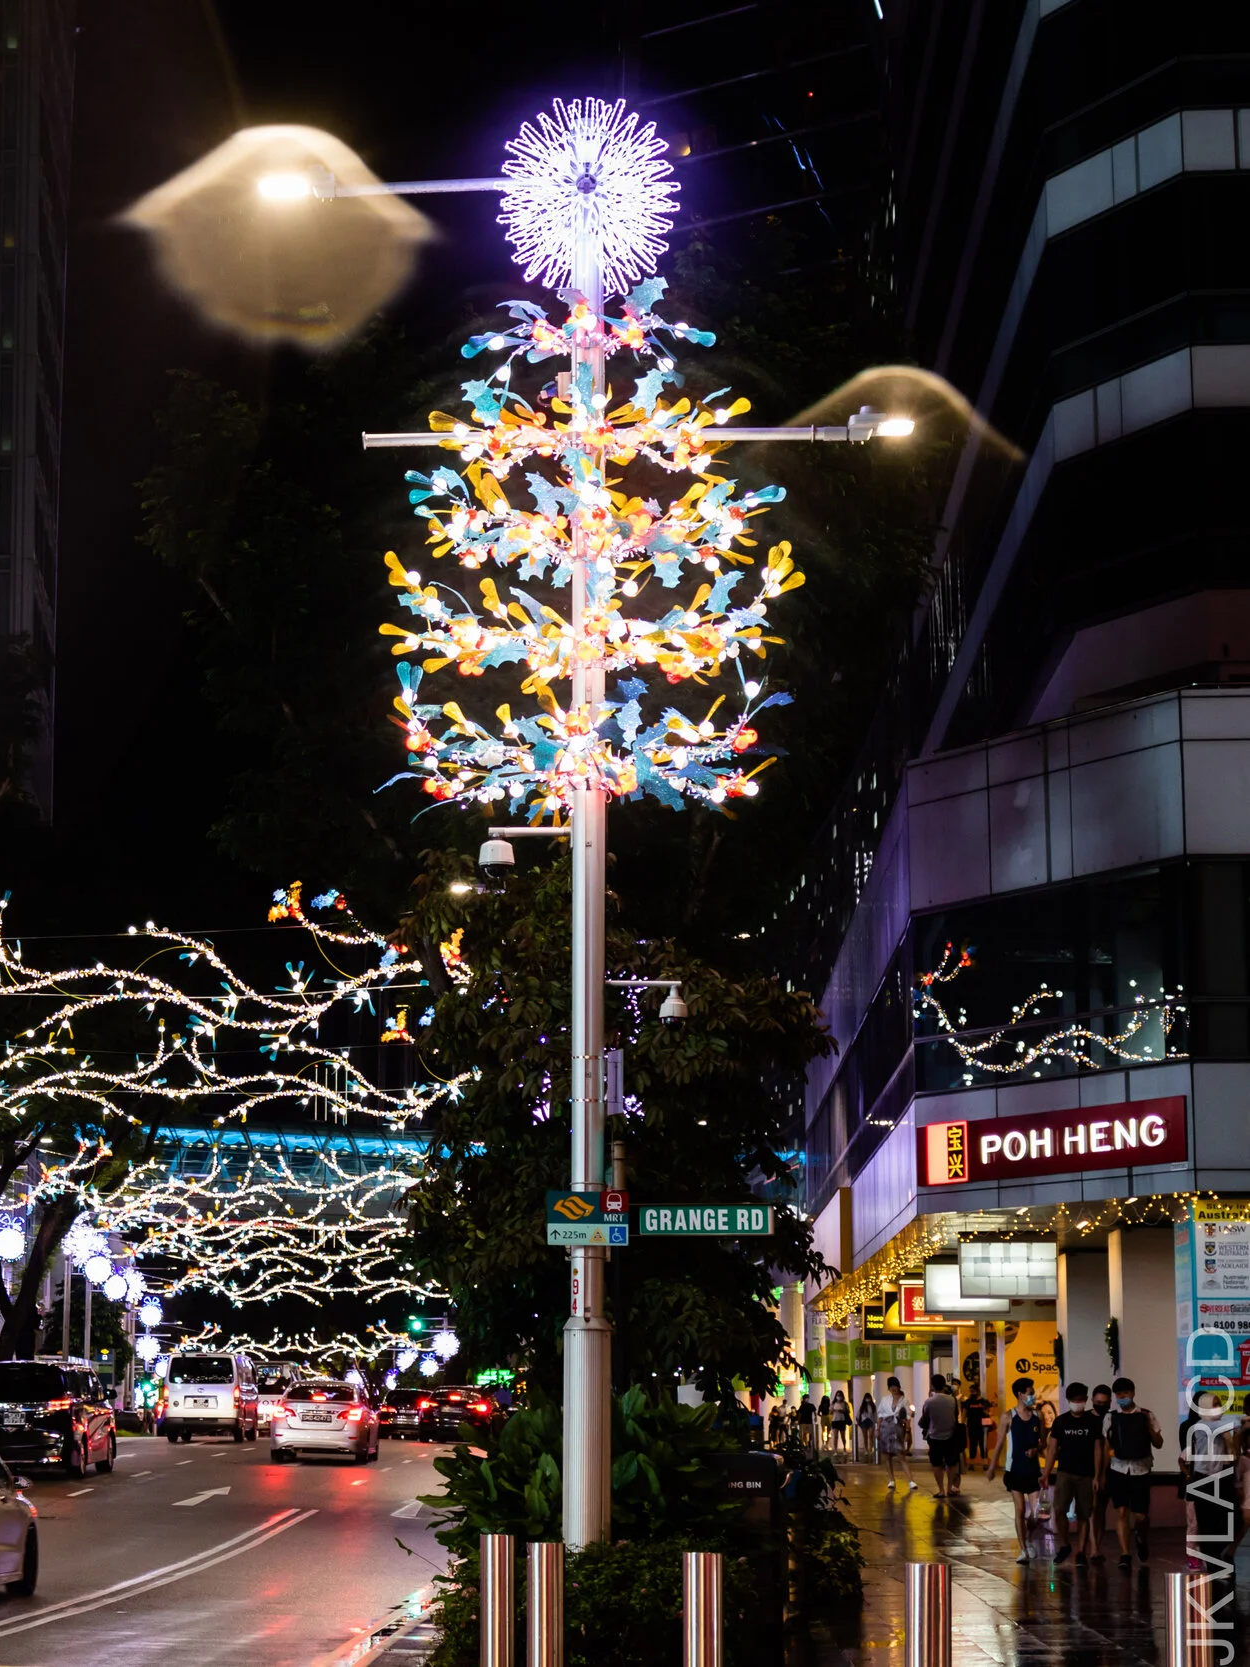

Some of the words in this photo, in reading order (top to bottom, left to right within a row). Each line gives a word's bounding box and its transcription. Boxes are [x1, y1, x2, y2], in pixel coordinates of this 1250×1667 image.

[980, 1127, 1051, 1165] POH
[1064, 1115, 1166, 1155] HENG
[947, 1126, 964, 1177] 宝兴
[603, 1213, 624, 1222] MRT
[645, 1208, 729, 1231] GRANGE
[736, 1208, 764, 1230] RD
[562, 1231, 587, 1239] 225m
[745, 1481, 762, 1489] BIN
